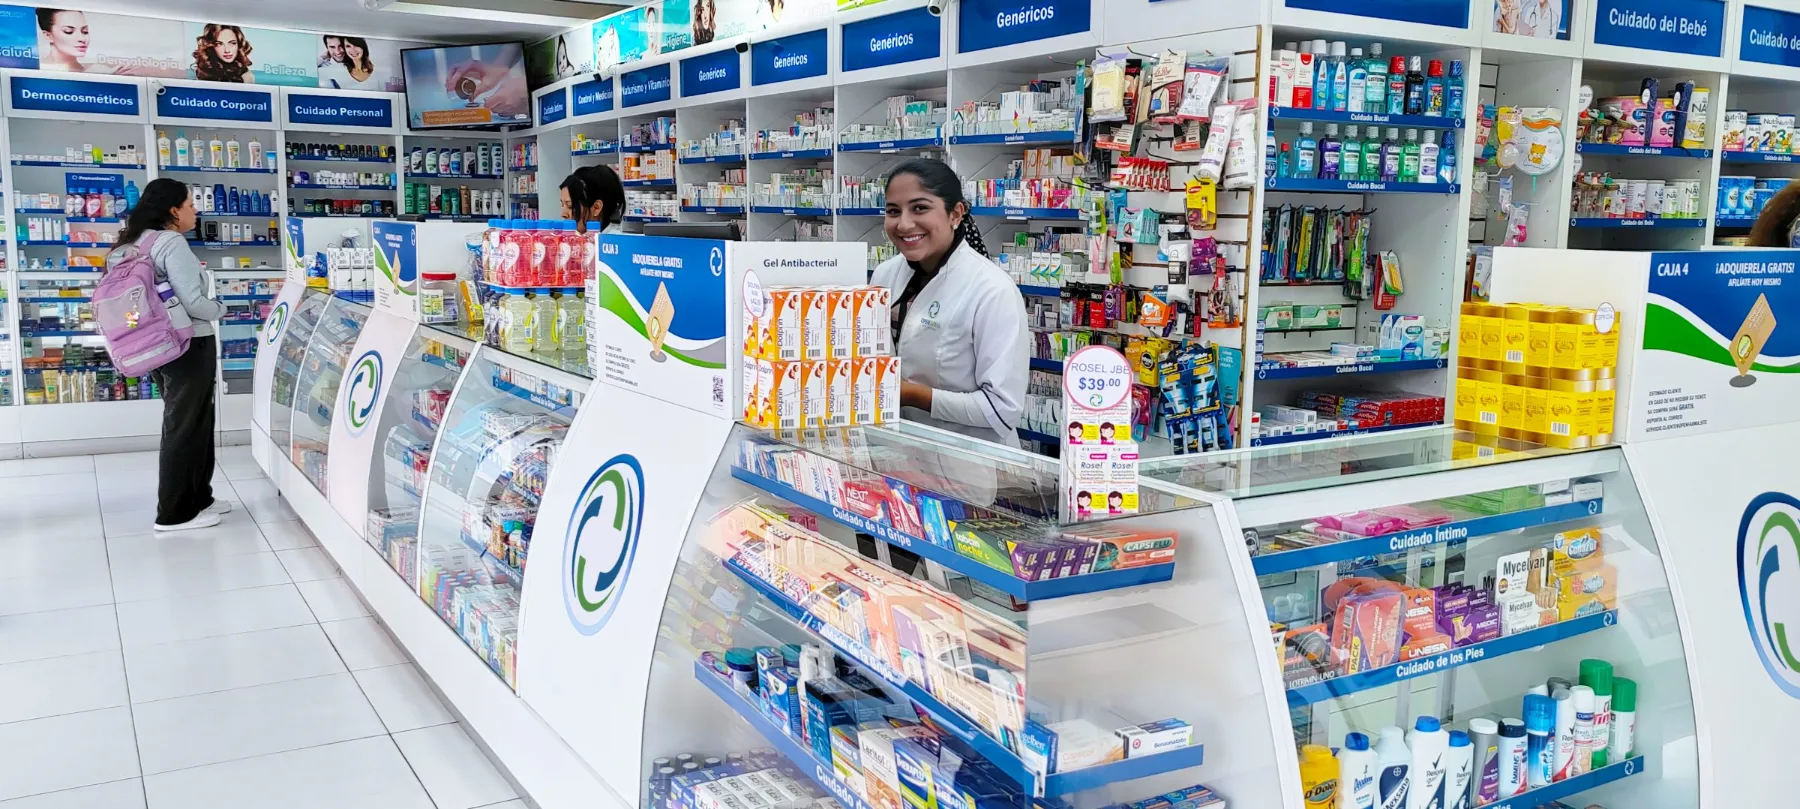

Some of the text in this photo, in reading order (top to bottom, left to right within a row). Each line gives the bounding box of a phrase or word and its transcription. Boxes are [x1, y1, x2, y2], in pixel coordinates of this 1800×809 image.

[997, 6, 1054, 28] Genéricos
[1609, 8, 1707, 37] Cuidado del Bebé
[666, 33, 686, 50] Higiene
[870, 33, 913, 52] Genéricos
[1750, 28, 1780, 47] Cuidado
[774, 53, 808, 69] Genéricos
[264, 64, 306, 77] Belleza
[699, 68, 726, 81] Genéricos
[22, 89, 133, 107] Dermocosméticos
[171, 96, 267, 112] Cuidado Corporal
[578, 95, 592, 104] Control
[295, 105, 383, 118] Cuidado Personal
[1351, 114, 1389, 122] Cuidado Bucal
[1761, 131, 1771, 145] 2
[1776, 129, 1786, 140] 3
[1747, 136, 1754, 148] 2
[1628, 146, 1642, 154] Cuidado
[602, 243, 618, 254] CAJA 3
[664, 256, 682, 268] GRATIS!
[764, 259, 837, 267] Gel Antibacterial
[1716, 263, 1795, 274] ¡ADQUIERELA GRATIS!
[1658, 263, 1689, 276] CAJA 4
[1751, 278, 1762, 286] HOY
[1763, 278, 1781, 286] MISMO
[1071, 363, 1106, 373] ROSEL
[1336, 364, 1374, 374] Cuidado Bucal
[811, 467, 821, 494] Rosel
[846, 488, 868, 501] NEXT
[833, 507, 911, 546] Cuidado de la Gripe
[1126, 538, 1170, 551] CAPSIFLU
[1390, 526, 1467, 550] Cuidado Íntimo
[958, 543, 982, 557] noche
[1503, 556, 1545, 575] Mycelvan
[1509, 601, 1533, 612] Mycelvan
[1476, 619, 1498, 629] MEDIC
[1351, 642, 1360, 671] PACK
[1409, 643, 1448, 658] UNESA
[1396, 647, 1484, 677] Cuidado de los Pies
[1289, 671, 1334, 688] LOTRIMIN UNO
[1154, 736, 1187, 748] Benzonatato
[862, 740, 885, 764] Laritol
[1426, 768, 1445, 776] Rexona
[816, 765, 854, 808] Cuidado
